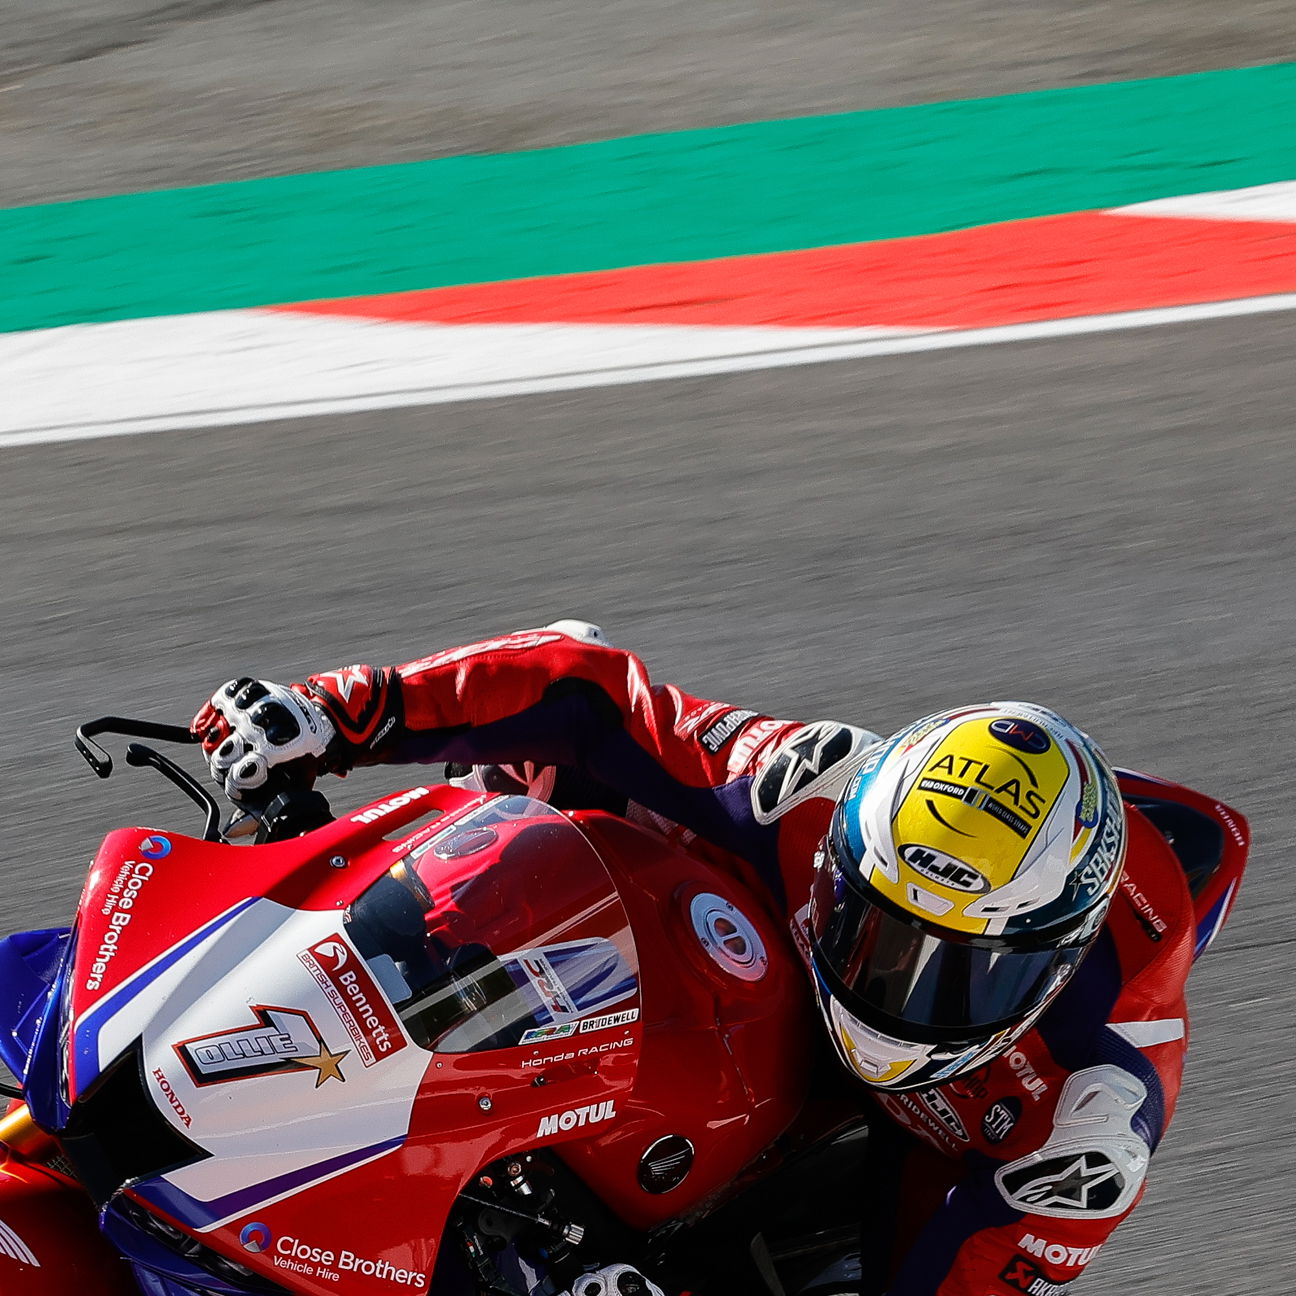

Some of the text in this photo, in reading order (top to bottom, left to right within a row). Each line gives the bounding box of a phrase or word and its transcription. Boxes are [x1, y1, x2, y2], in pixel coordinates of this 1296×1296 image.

[350, 786, 430, 824] MOTUL
[928, 754, 1046, 820] ATLAS
[101, 859, 137, 916] Vehicle Hire
[904, 849, 980, 888] HJC
[86, 861, 154, 992] Close Brothers
[299, 951, 374, 1064] BRITISH SUPERBIKES
[338, 970, 394, 1054] Bennetts
[581, 1010, 639, 1033] BRIDEWELL
[193, 1032, 299, 1065] OLLIE
[521, 1052, 575, 1069] Honda
[577, 1037, 634, 1057] RACING
[152, 1068, 193, 1129] HONDA
[536, 1100, 617, 1137] MOTUL
[984, 1103, 1015, 1140] STM
[272, 1255, 340, 1282] Vehicle Hire
[275, 1235, 426, 1289] Close Brothers
